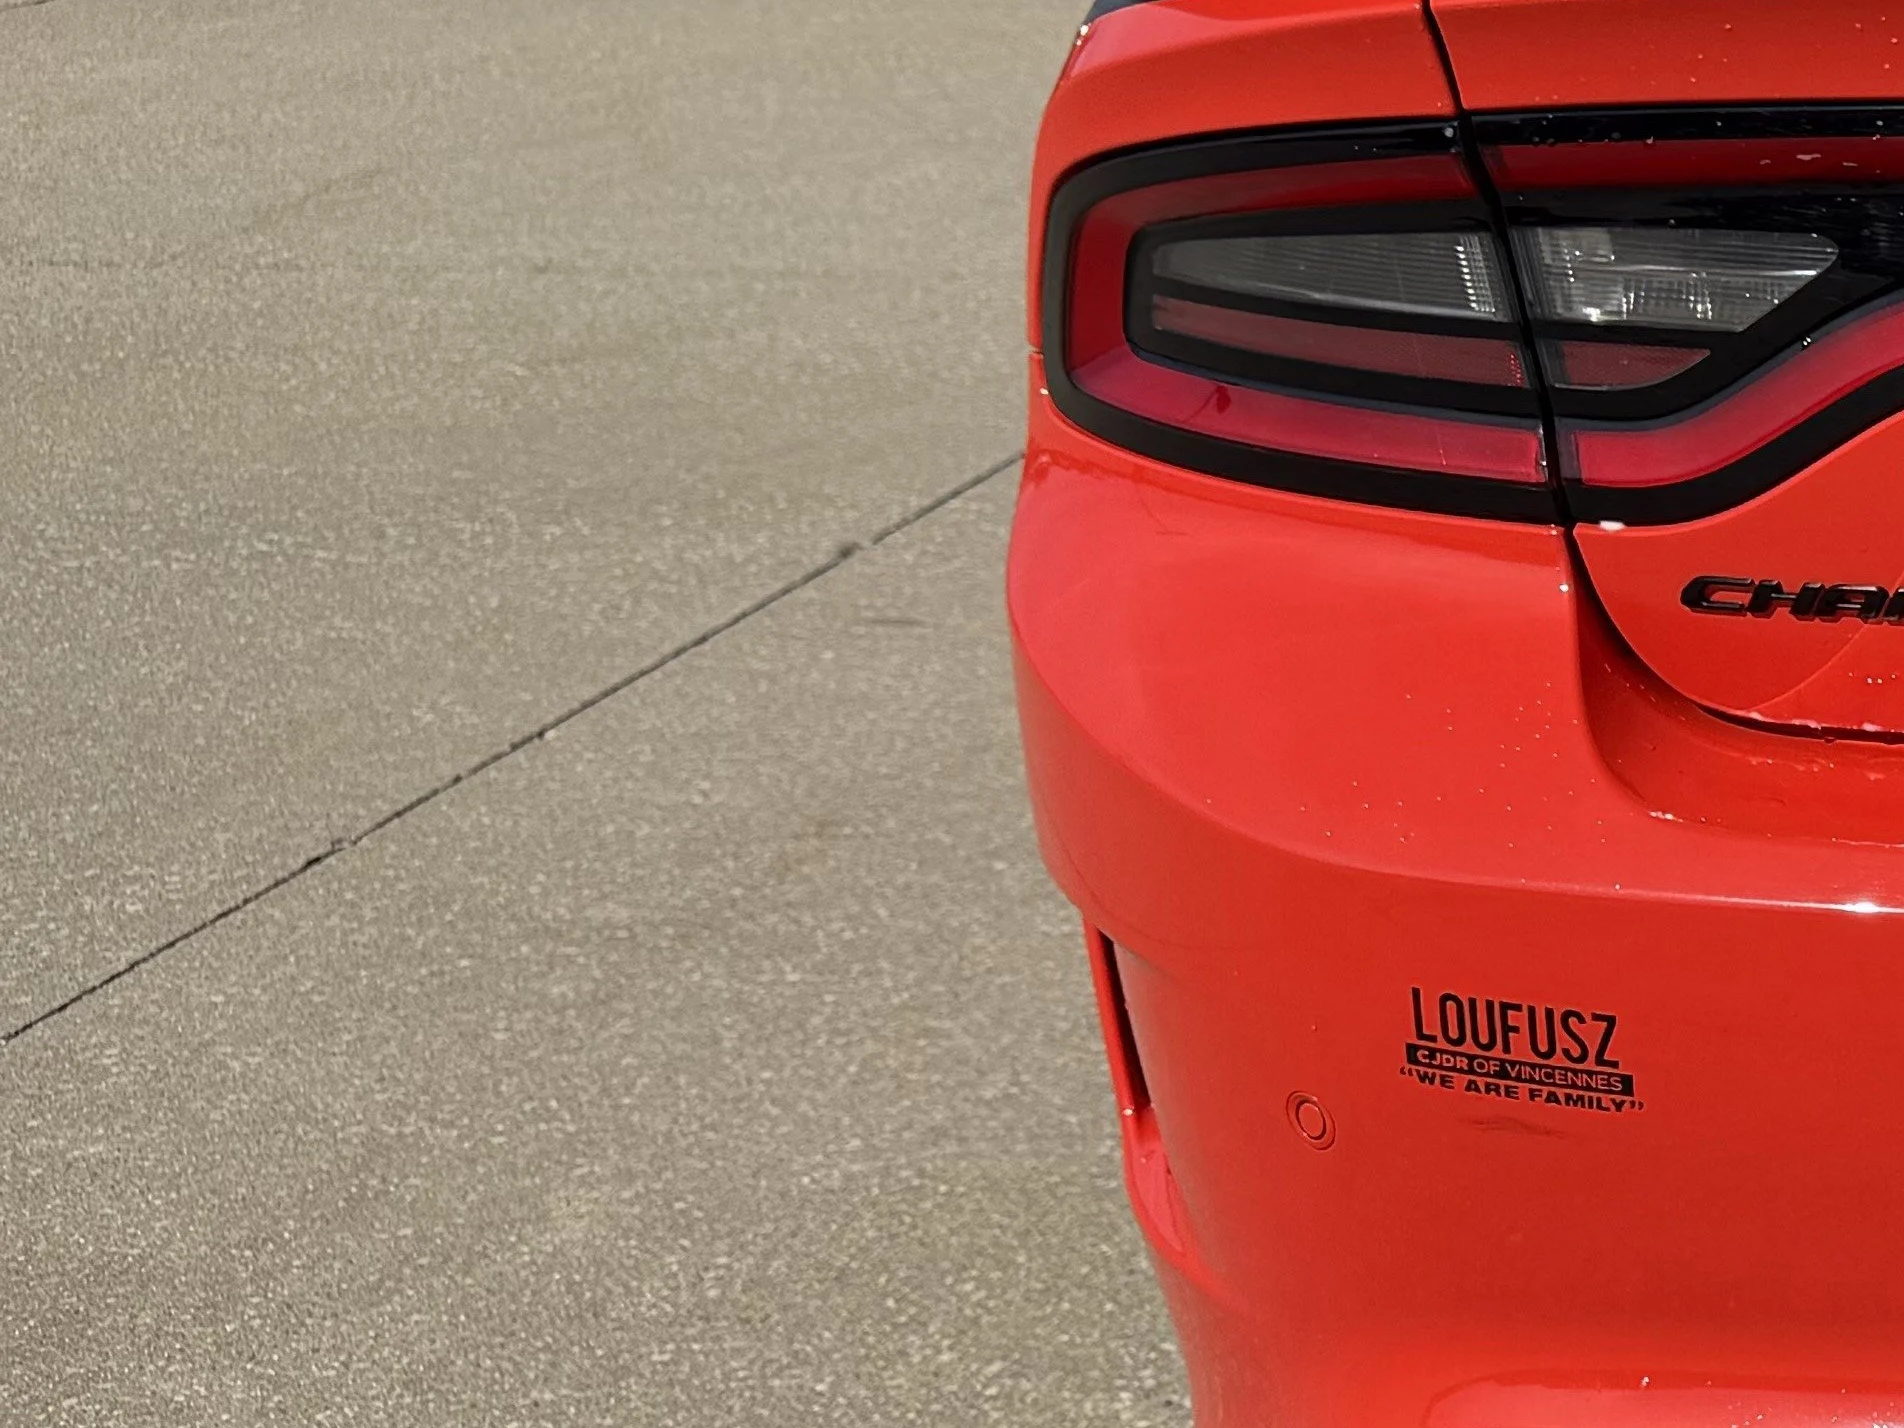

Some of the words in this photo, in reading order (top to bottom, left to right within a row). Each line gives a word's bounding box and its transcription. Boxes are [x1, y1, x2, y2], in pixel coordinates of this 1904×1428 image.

[1416, 1049, 1469, 1071] CJDR
[1473, 1058, 1500, 1075] OF
[1505, 1062, 1623, 1092] VINCENNES
[1464, 1078, 1520, 1101] ARE
